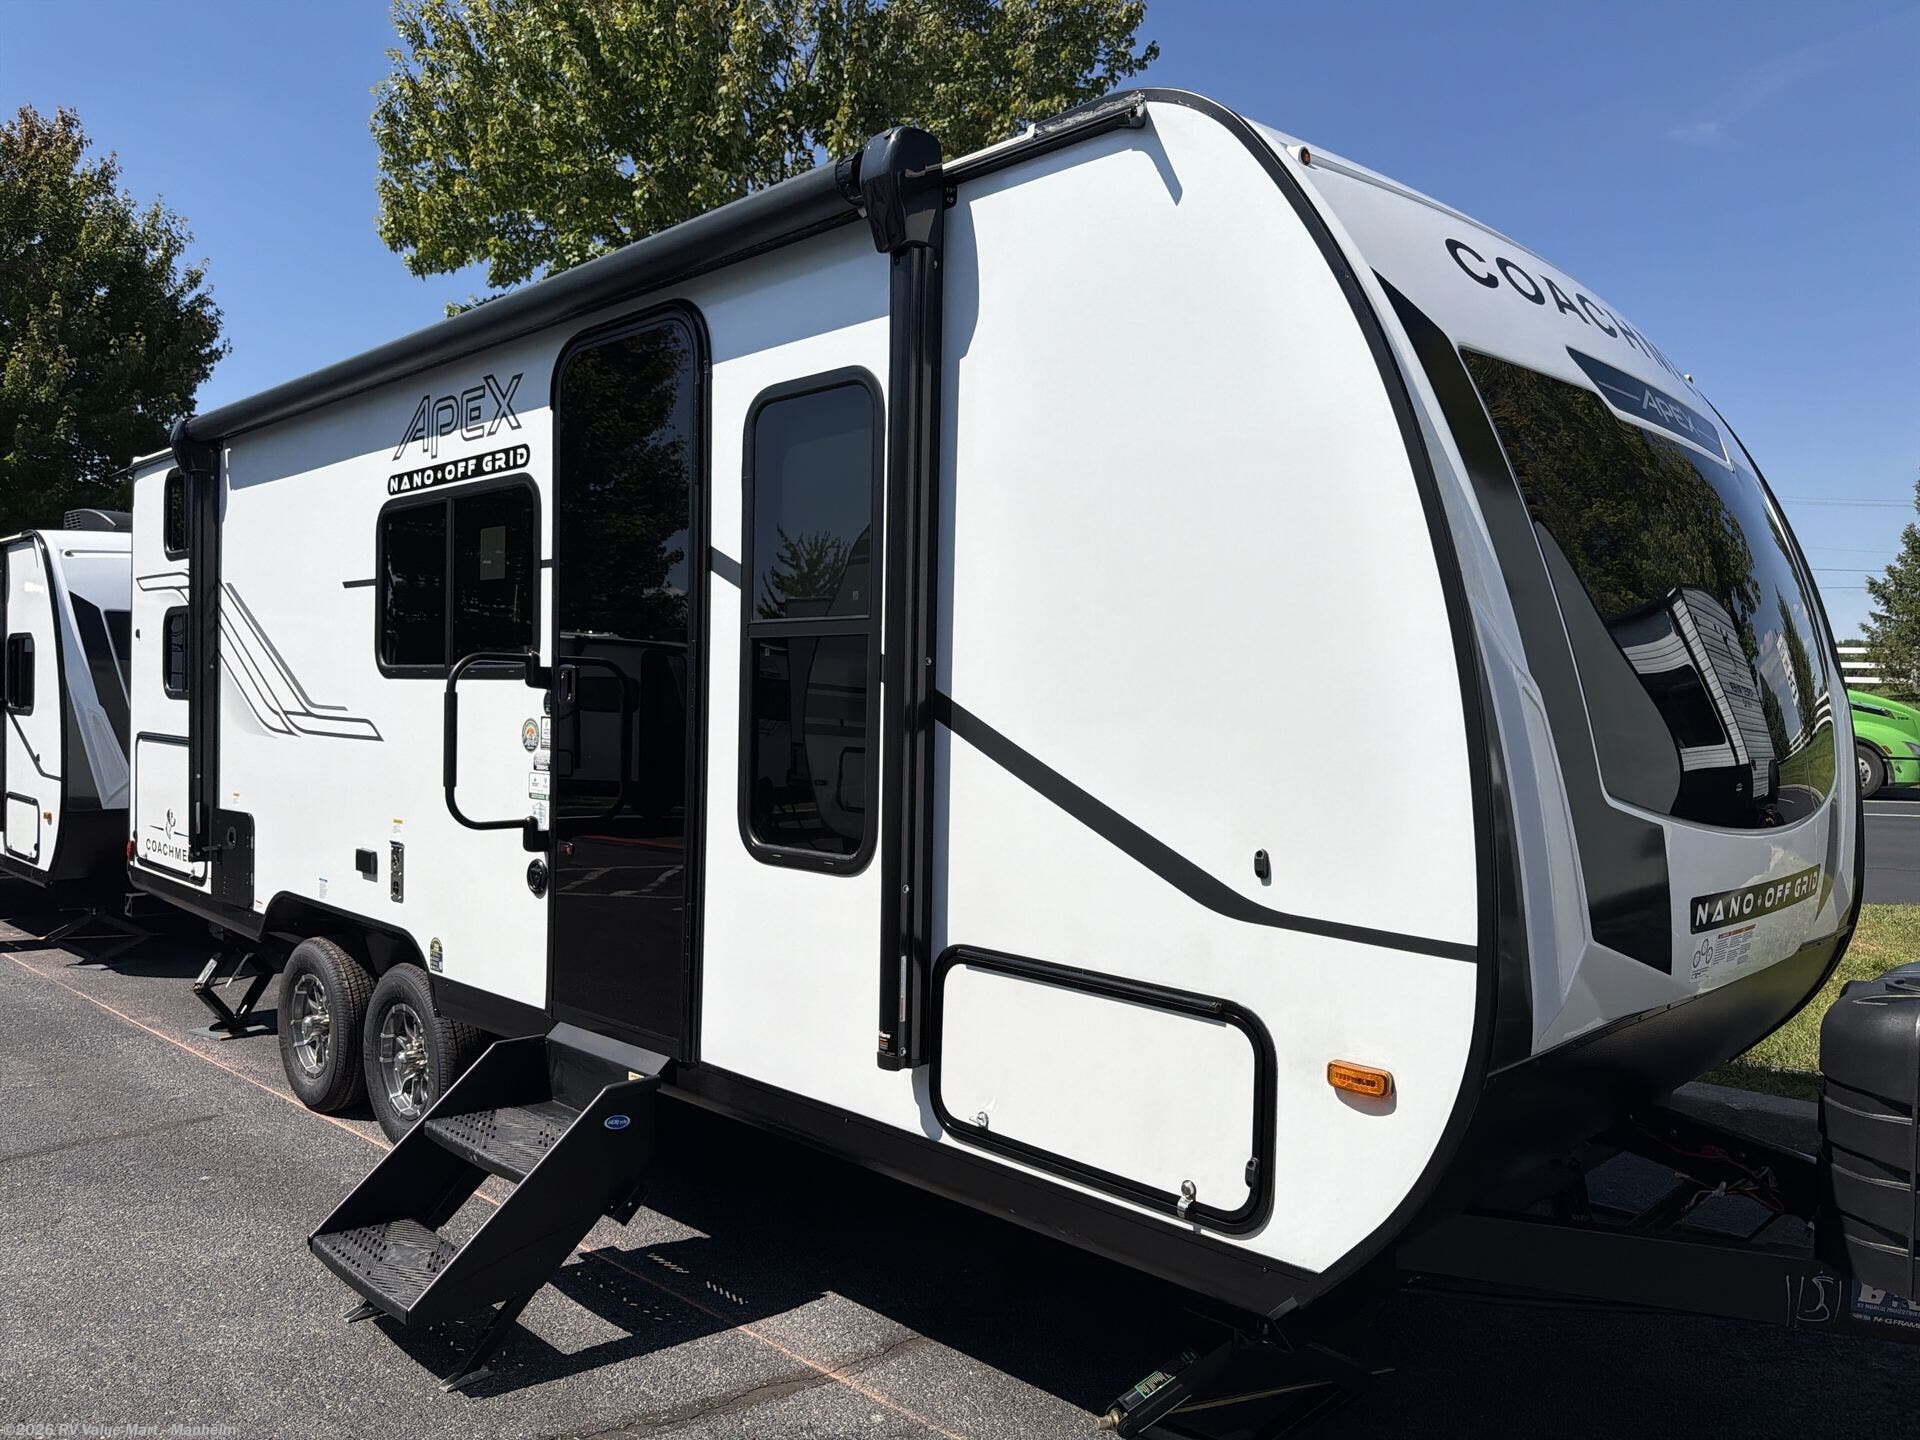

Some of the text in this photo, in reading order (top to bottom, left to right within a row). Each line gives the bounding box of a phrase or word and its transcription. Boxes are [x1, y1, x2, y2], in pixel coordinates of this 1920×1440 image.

[392, 373, 524, 460] APEX
[1642, 388, 1695, 433] APEX
[389, 447, 528, 493] NANO OFF GRID
[145, 838, 188, 862] COACHME
[1695, 871, 1818, 926] NANO OFF GRID
